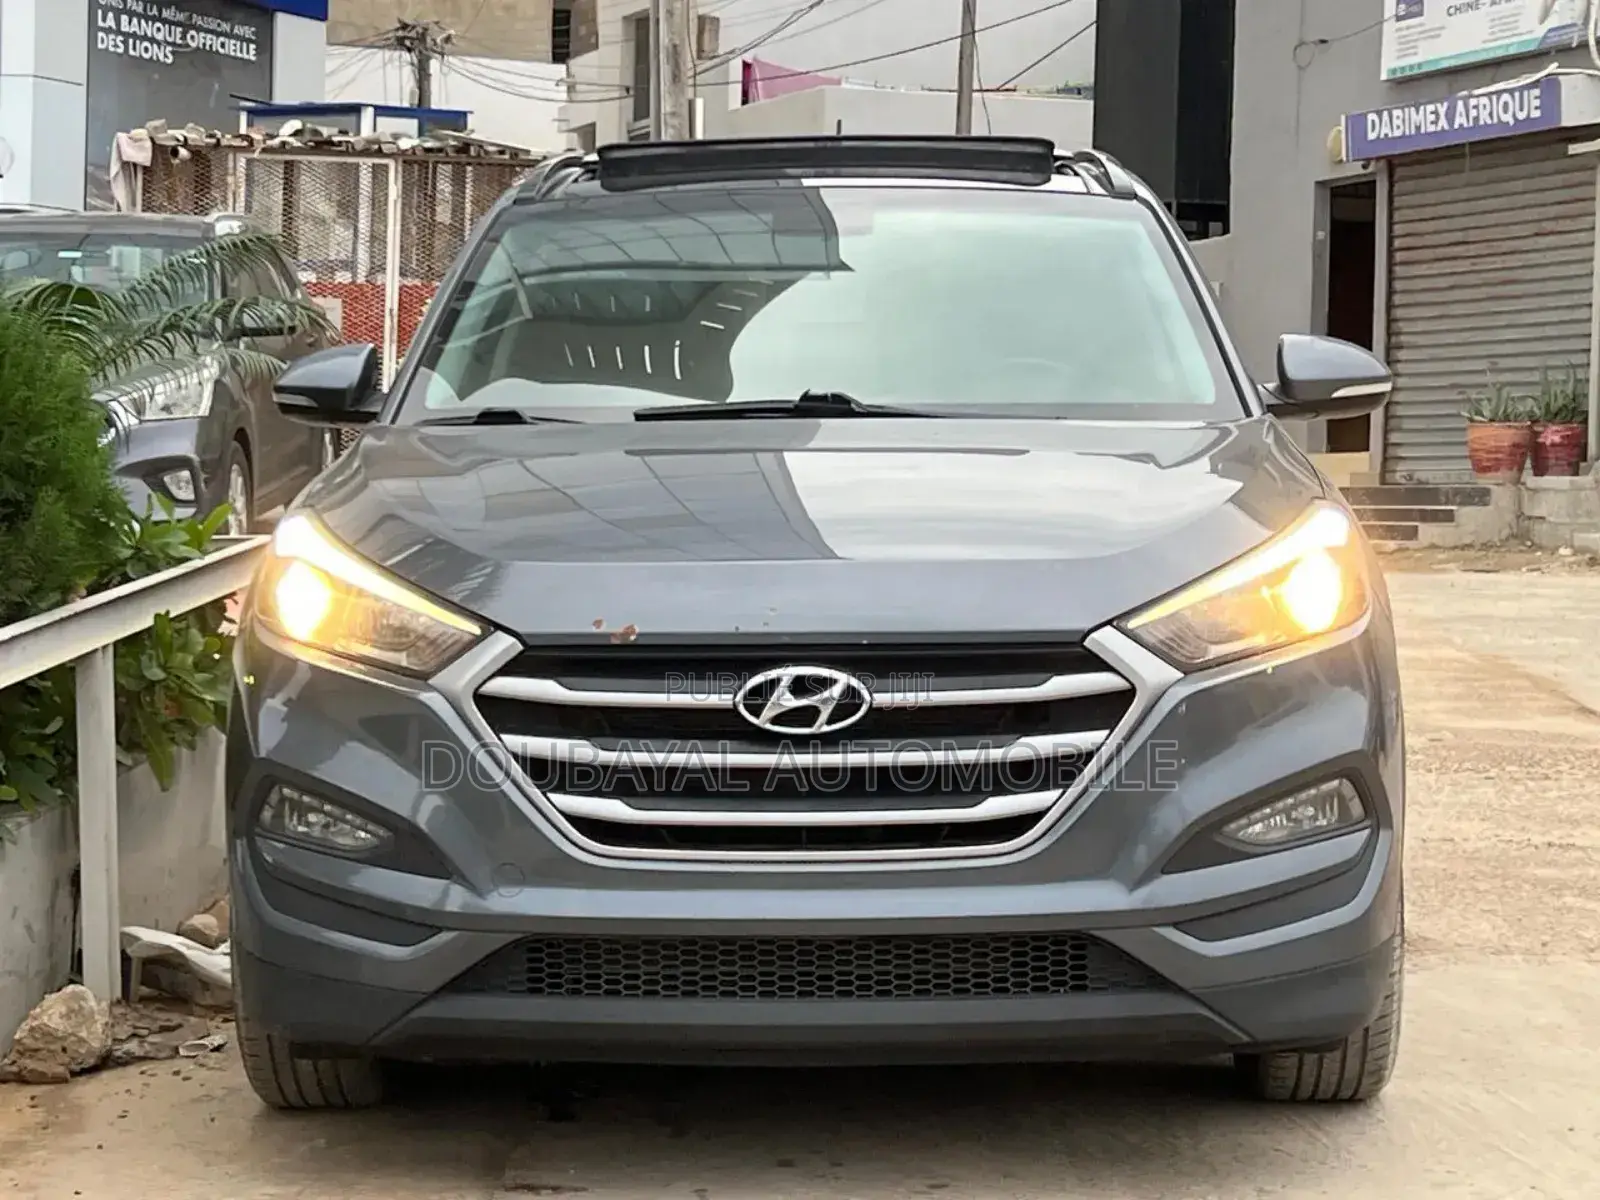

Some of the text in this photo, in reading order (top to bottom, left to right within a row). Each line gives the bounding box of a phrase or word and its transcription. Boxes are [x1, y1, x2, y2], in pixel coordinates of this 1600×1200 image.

[97, 9, 257, 61] LA BANQUE OFFICIELLE
[147, 3, 159, 17] LA
[192, 13, 231, 33] PASSION
[233, 24, 257, 40] AVEC
[97, 31, 174, 65] DES LIONS
[1367, 88, 1542, 141] DABIMEX AFRIQUE
